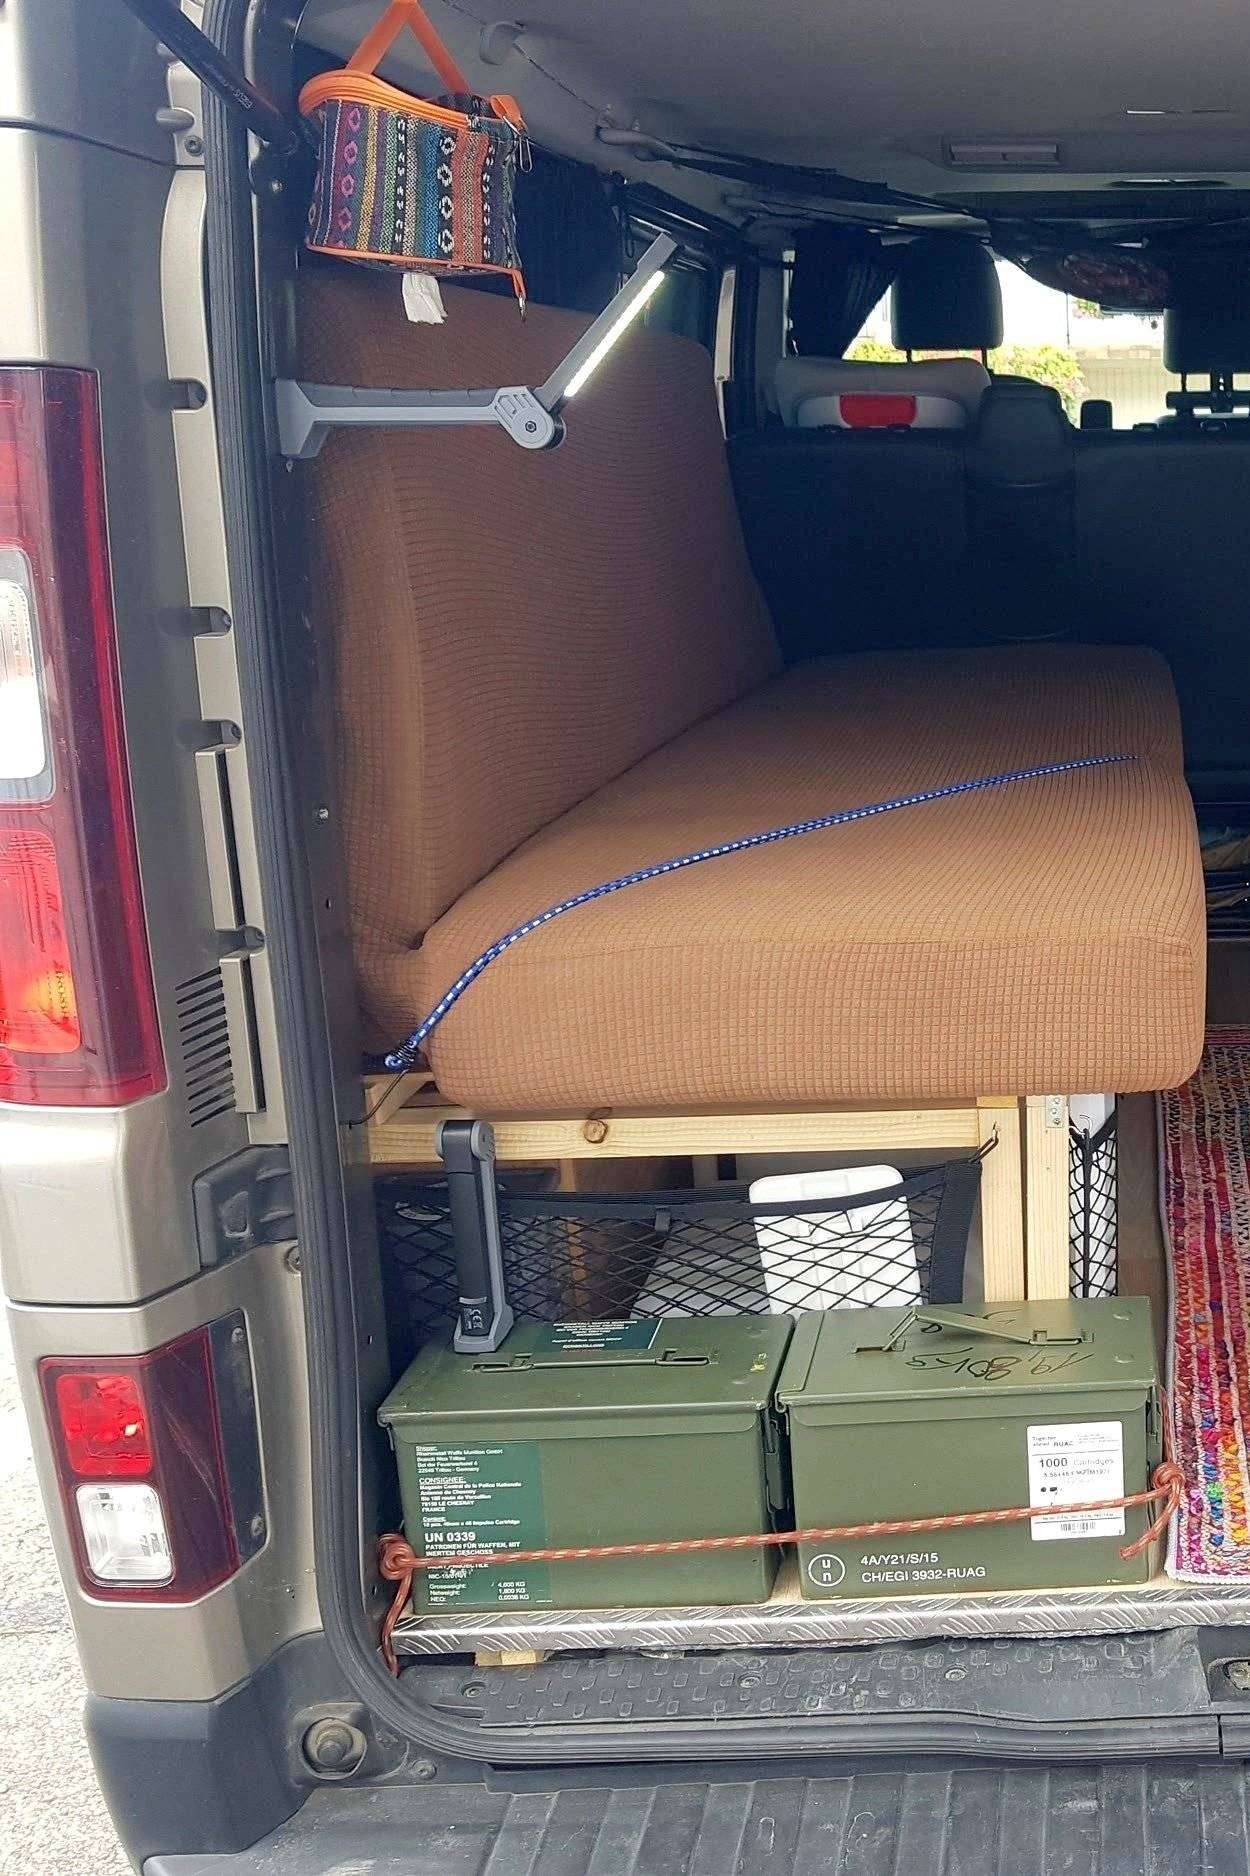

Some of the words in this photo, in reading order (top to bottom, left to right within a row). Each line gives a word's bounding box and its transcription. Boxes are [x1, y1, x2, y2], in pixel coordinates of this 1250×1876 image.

[1039, 1458, 1068, 1468] 1000
[1073, 1458, 1114, 1466] Cartridges
[424, 1533, 444, 1542] UN
[447, 1532, 476, 1542] 0339
[861, 1553, 938, 1565] 4A/Y21/S/15
[862, 1570, 908, 1582] CH/EGI
[912, 1567, 986, 1581] 3932-RUAG
